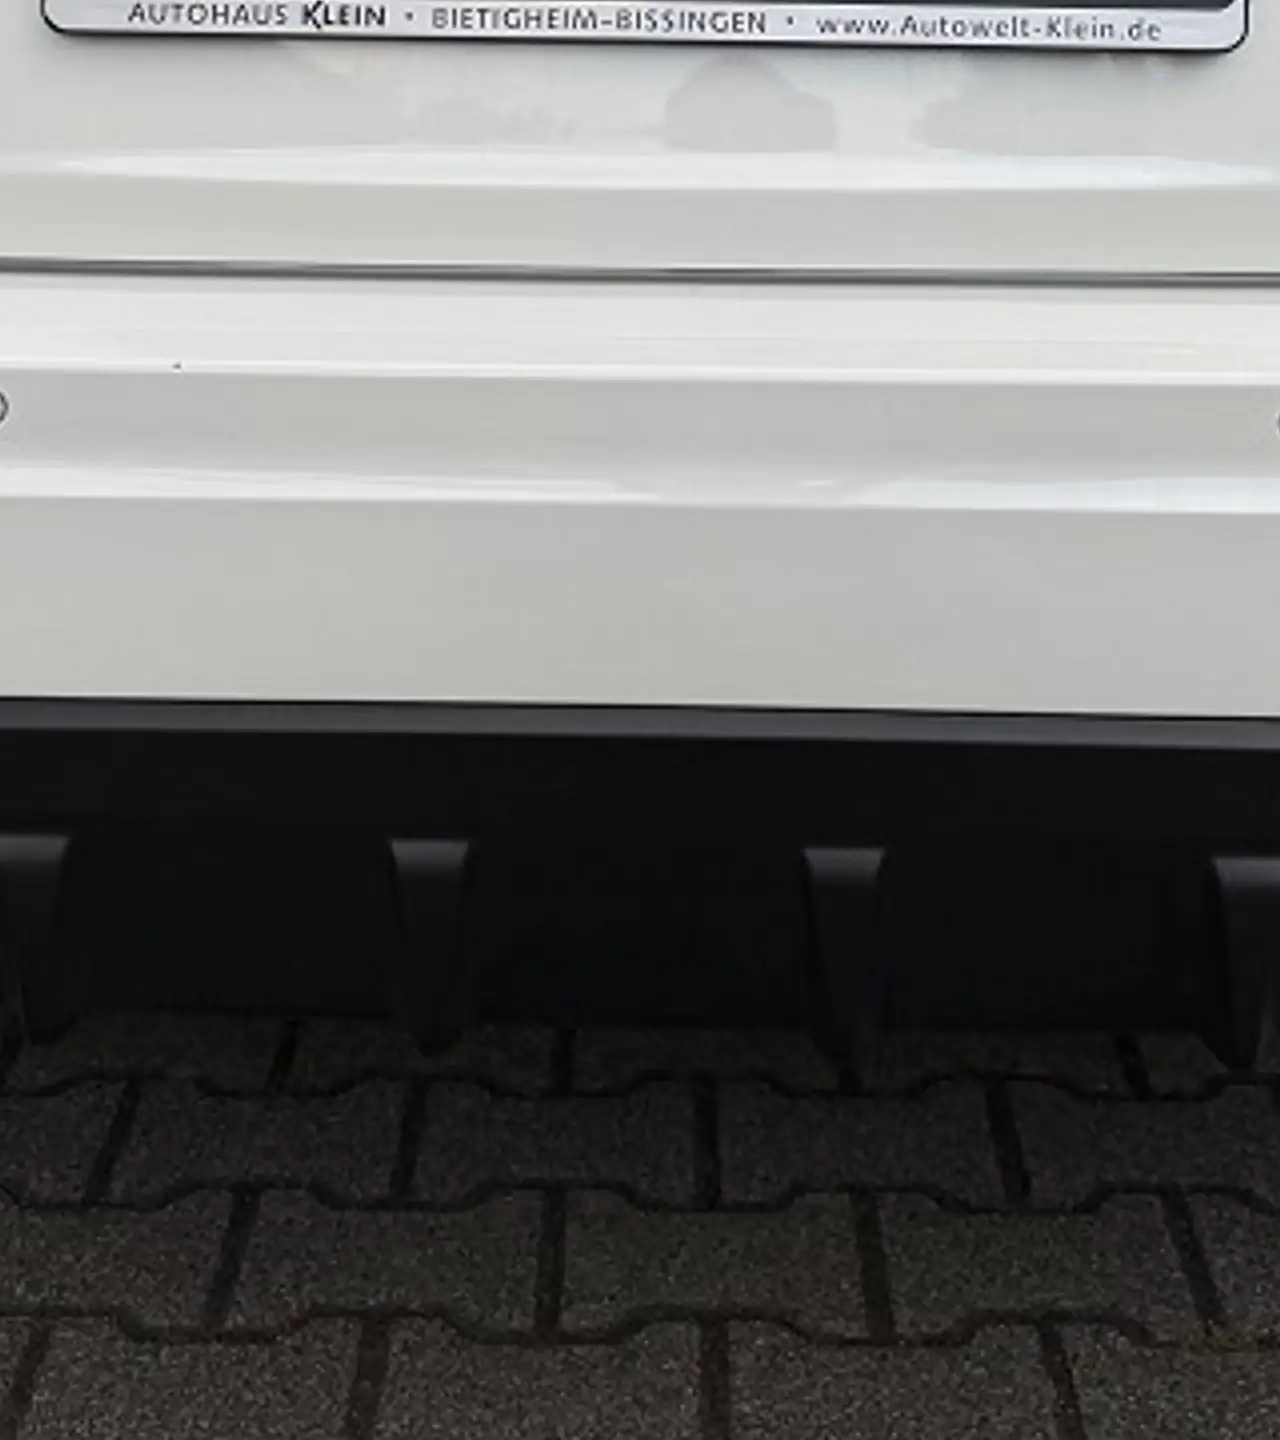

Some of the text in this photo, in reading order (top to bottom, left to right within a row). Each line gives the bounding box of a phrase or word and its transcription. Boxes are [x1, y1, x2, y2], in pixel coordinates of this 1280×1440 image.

[128, 0, 1161, 41] AUTOHAUS KLEIN BIETIGHEIM-BISSINGEN www.Autowelt-Klein.de
